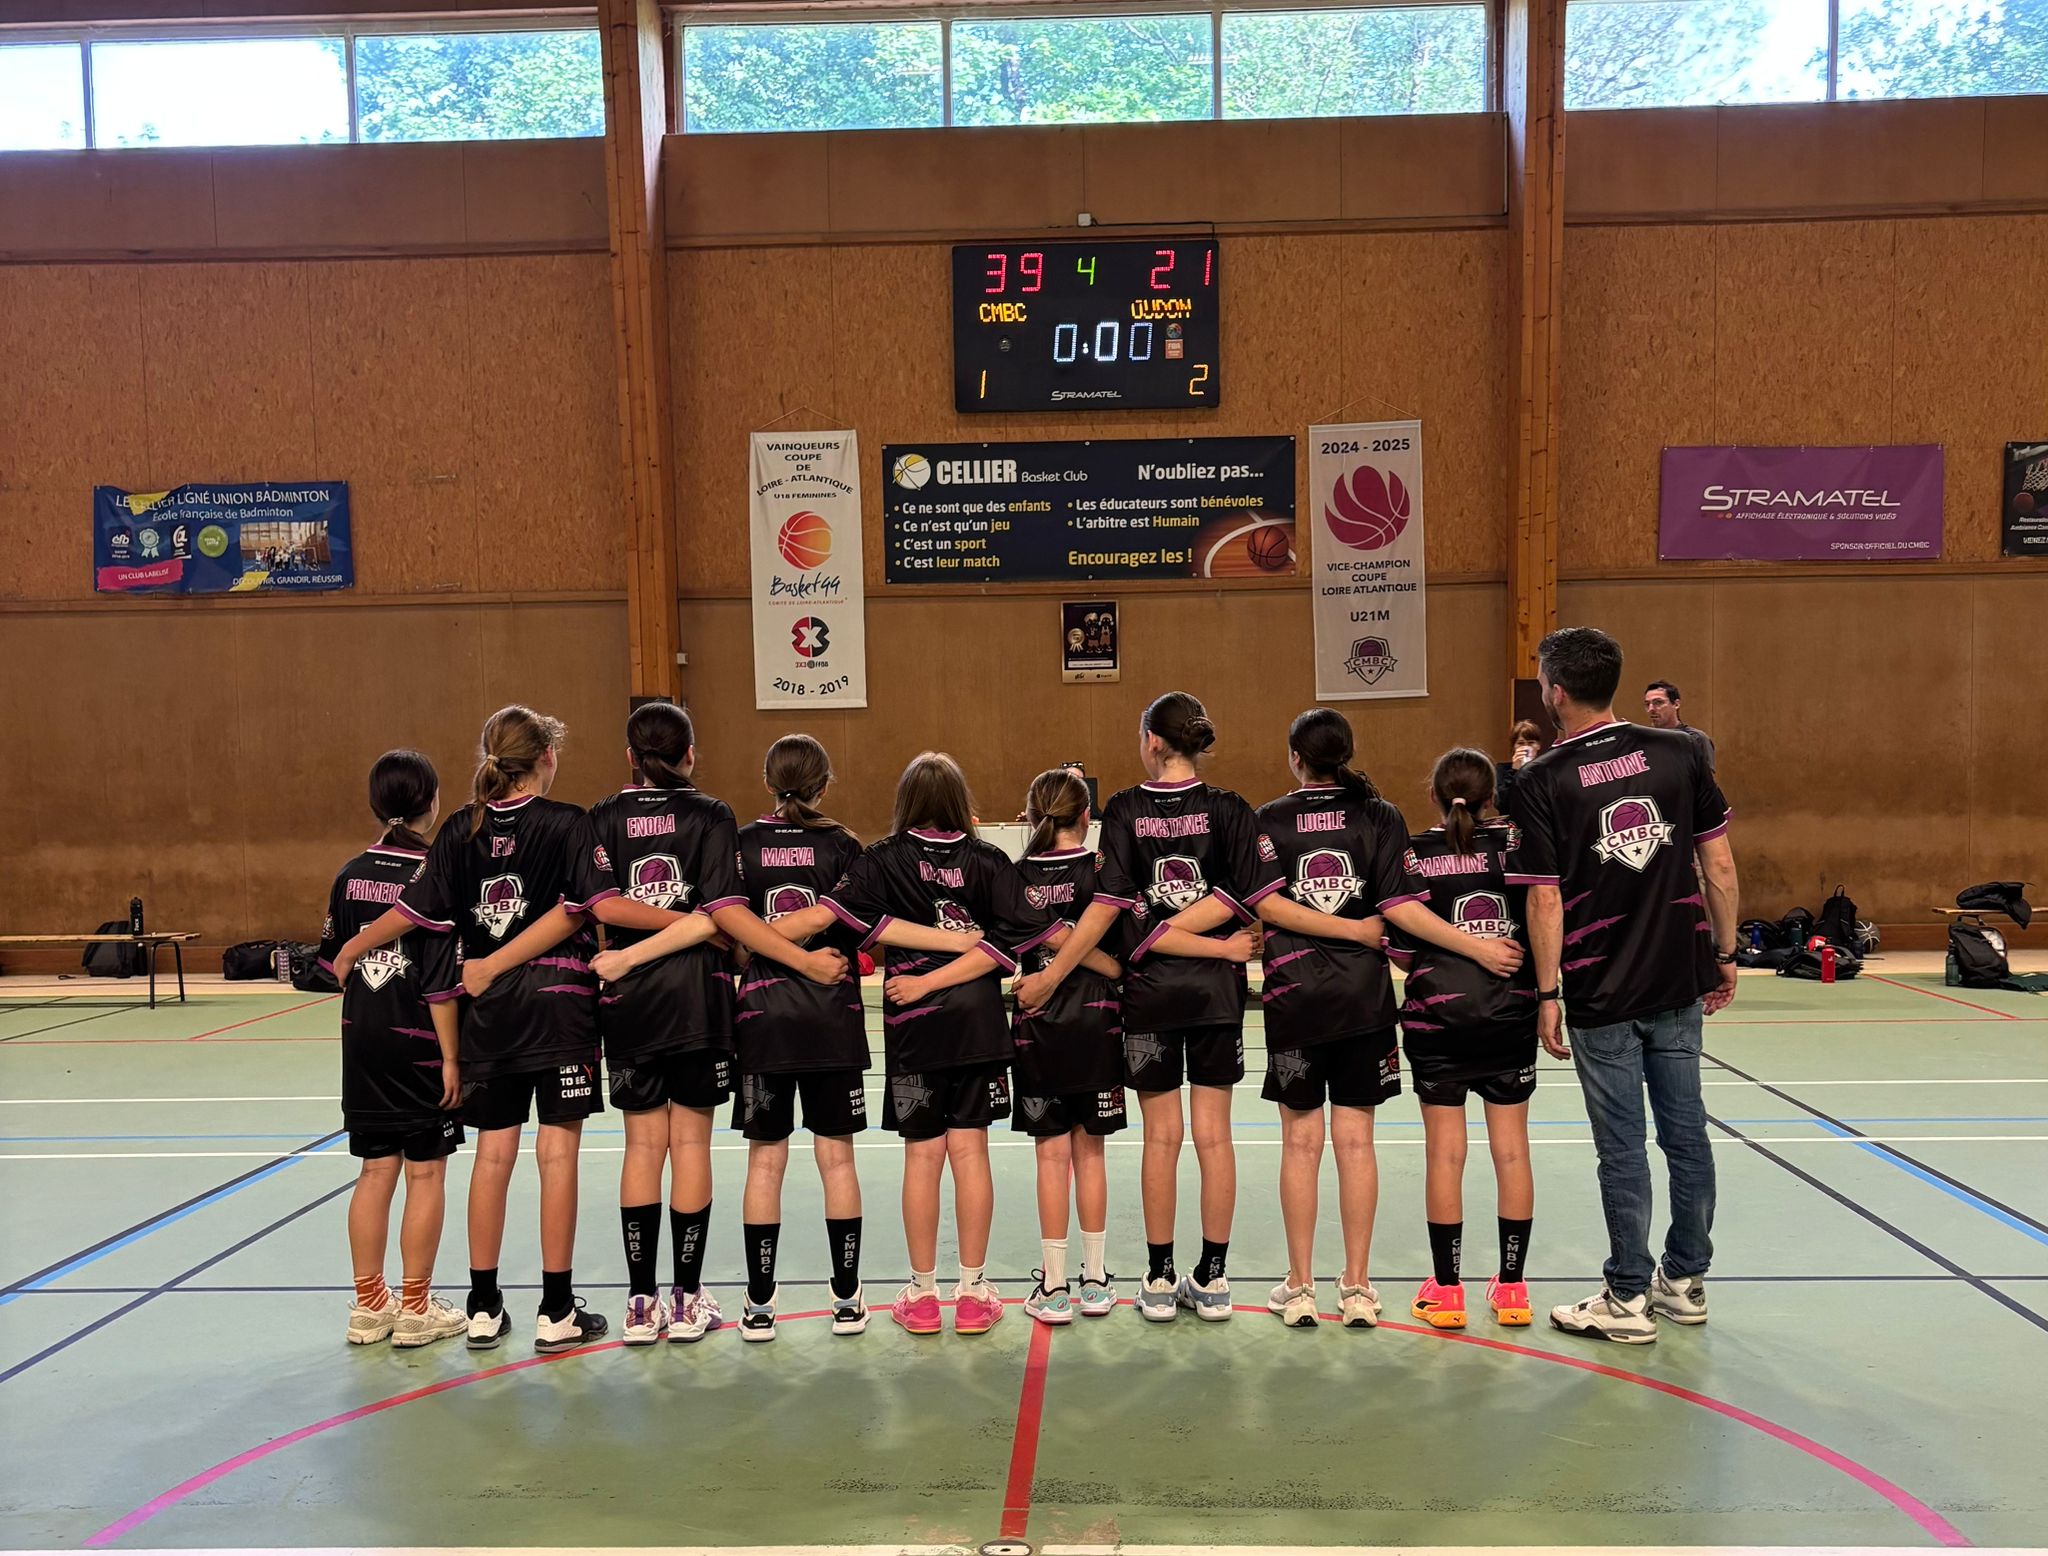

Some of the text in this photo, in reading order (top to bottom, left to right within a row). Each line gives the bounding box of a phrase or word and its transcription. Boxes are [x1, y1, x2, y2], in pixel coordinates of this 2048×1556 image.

[986, 252, 1043, 293] 39
[1077, 256, 1096, 286] 4
[1150, 249, 1212, 290] 21
[979, 302, 1027, 323] CMBC
[1053, 322, 1153, 362] 0:00
[1189, 363, 1208, 395] 2
[1050, 389, 1122, 401] STRAMATEL
[767, 442, 840, 451] VAINQUEURS
[1321, 441, 1359, 454] 2024
[1372, 438, 1410, 452] 2025
[784, 453, 822, 461] COUPE
[936, 459, 1088, 485] CELLIER Basket Club
[1138, 463, 1216, 481] N'oubliez
[756, 478, 784, 496] LOIRE
[791, 474, 853, 494] ATLANTIQUE
[116, 495, 130, 507] LE
[178, 490, 209, 505] LIGNÉ
[213, 491, 253, 504] UNION
[256, 489, 329, 503] BADMINTON
[1076, 495, 1264, 511] Les éducateurs sont bénévoles
[1700, 485, 1900, 511] STRAMATEL
[225, 508, 237, 518] de
[240, 507, 293, 518] Badminton
[903, 500, 1051, 516] Ce ne sont que des enfants
[903, 518, 1010, 534] Ce n'est qu'un jeu
[1076, 515, 1200, 529] L'arbitre est Humain
[903, 538, 986, 552] C'est un sport
[903, 555, 1000, 568] C'est leur match
[1068, 549, 1156, 567] Encouragez
[1161, 548, 1184, 564] les
[1327, 559, 1410, 571] VICE-CHAMPION
[1351, 572, 1387, 582] COUPE
[1322, 583, 1417, 596] LOIRE ATLANTIQUE
[1350, 610, 1390, 622] U21M
[1353, 657, 1389, 666] CMBC
[773, 677, 805, 695] 2018
[820, 675, 848, 695] 2019
[1578, 750, 1650, 788] ANTOINE
[627, 814, 676, 838] ENORA
[1135, 813, 1210, 838] CONSTANCE
[1296, 810, 1346, 832] LUCILE
[1607, 825, 1661, 848] CMBC
[761, 847, 815, 867] MAEVA
[633, 882, 680, 899] CMBC
[1157, 880, 1203, 895] CMBC
[1301, 878, 1352, 892] CMBC
[368, 952, 400, 965] MBC
[560, 1077, 573, 1086] TO
[628, 1222, 642, 1261] CMBC
[681, 1224, 701, 1263] CMBC
[843, 1233, 856, 1268] CMBC
[760, 1238, 772, 1274] CMBC
[1506, 1235, 1519, 1270] CMBC
